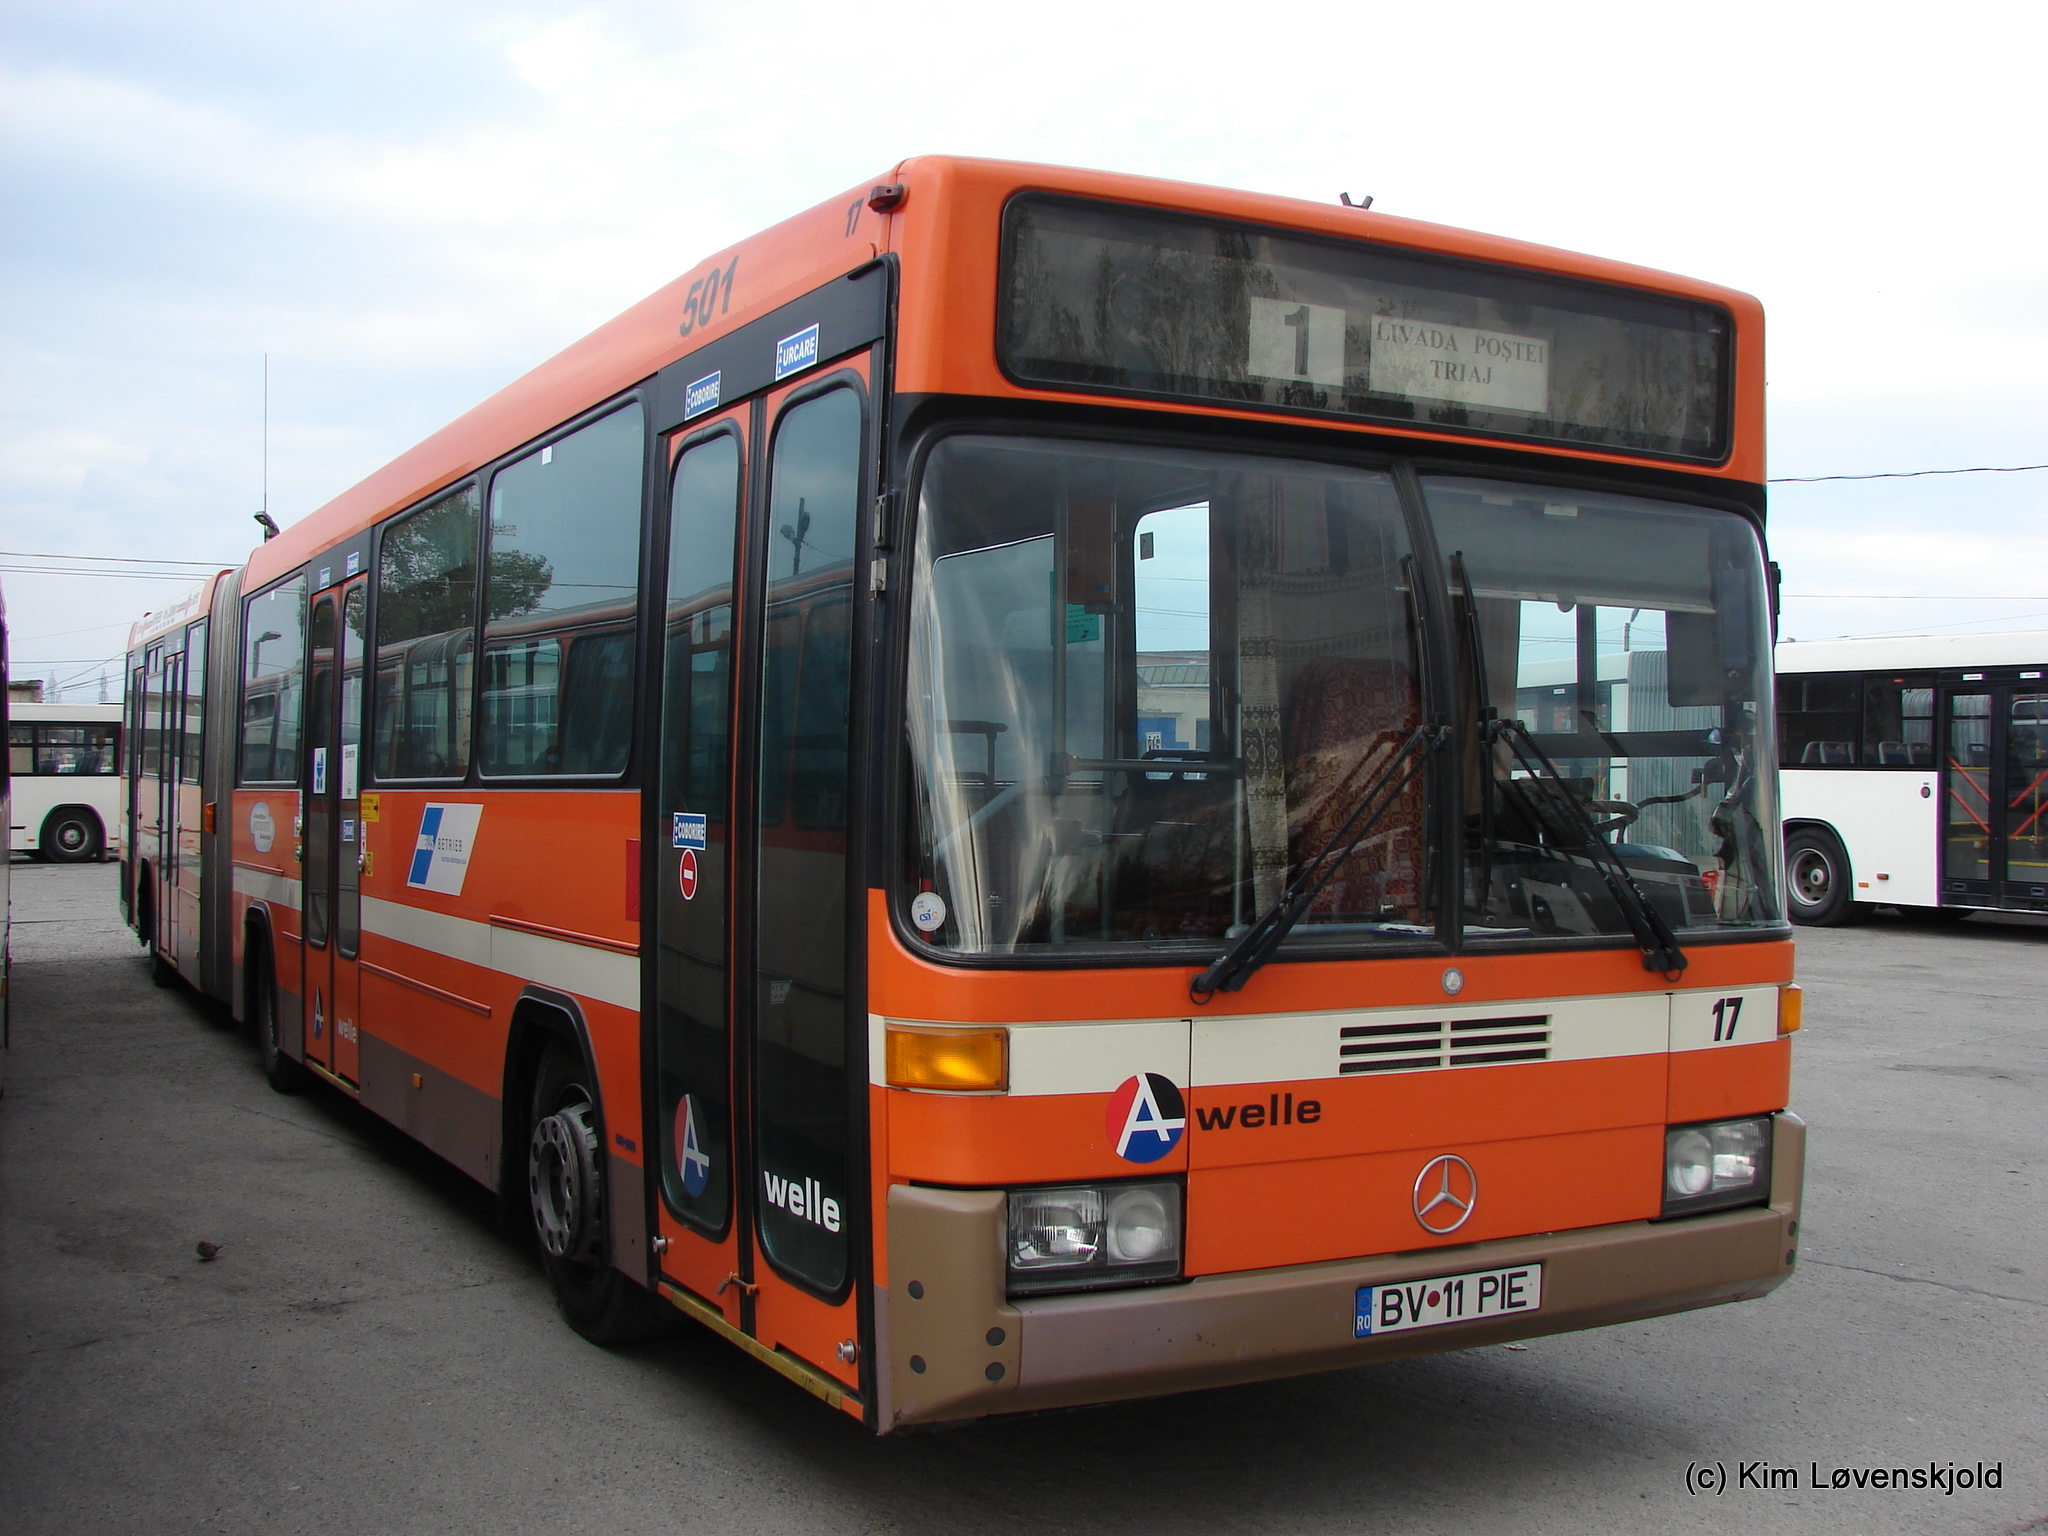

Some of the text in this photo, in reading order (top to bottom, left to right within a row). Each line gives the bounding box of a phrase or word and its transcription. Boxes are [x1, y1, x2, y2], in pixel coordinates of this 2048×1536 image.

[845, 198, 864, 238] 17
[679, 255, 740, 337] 501
[783, 335, 816, 367] URCARE
[1284, 305, 1310, 376] 1
[1376, 322, 1459, 352] LIVADA
[1430, 359, 1493, 385] TRIAJ
[690, 380, 719, 409] COBORIRE
[677, 820, 705, 841] COBORIRE
[337, 1017, 357, 1044] welle
[1712, 996, 1743, 1042] 17
[1195, 1092, 1322, 1131] welle
[764, 1170, 842, 1233] welle
[1380, 1270, 1528, 1327] BV 11 PIE
[1356, 1314, 1371, 1331] RO
